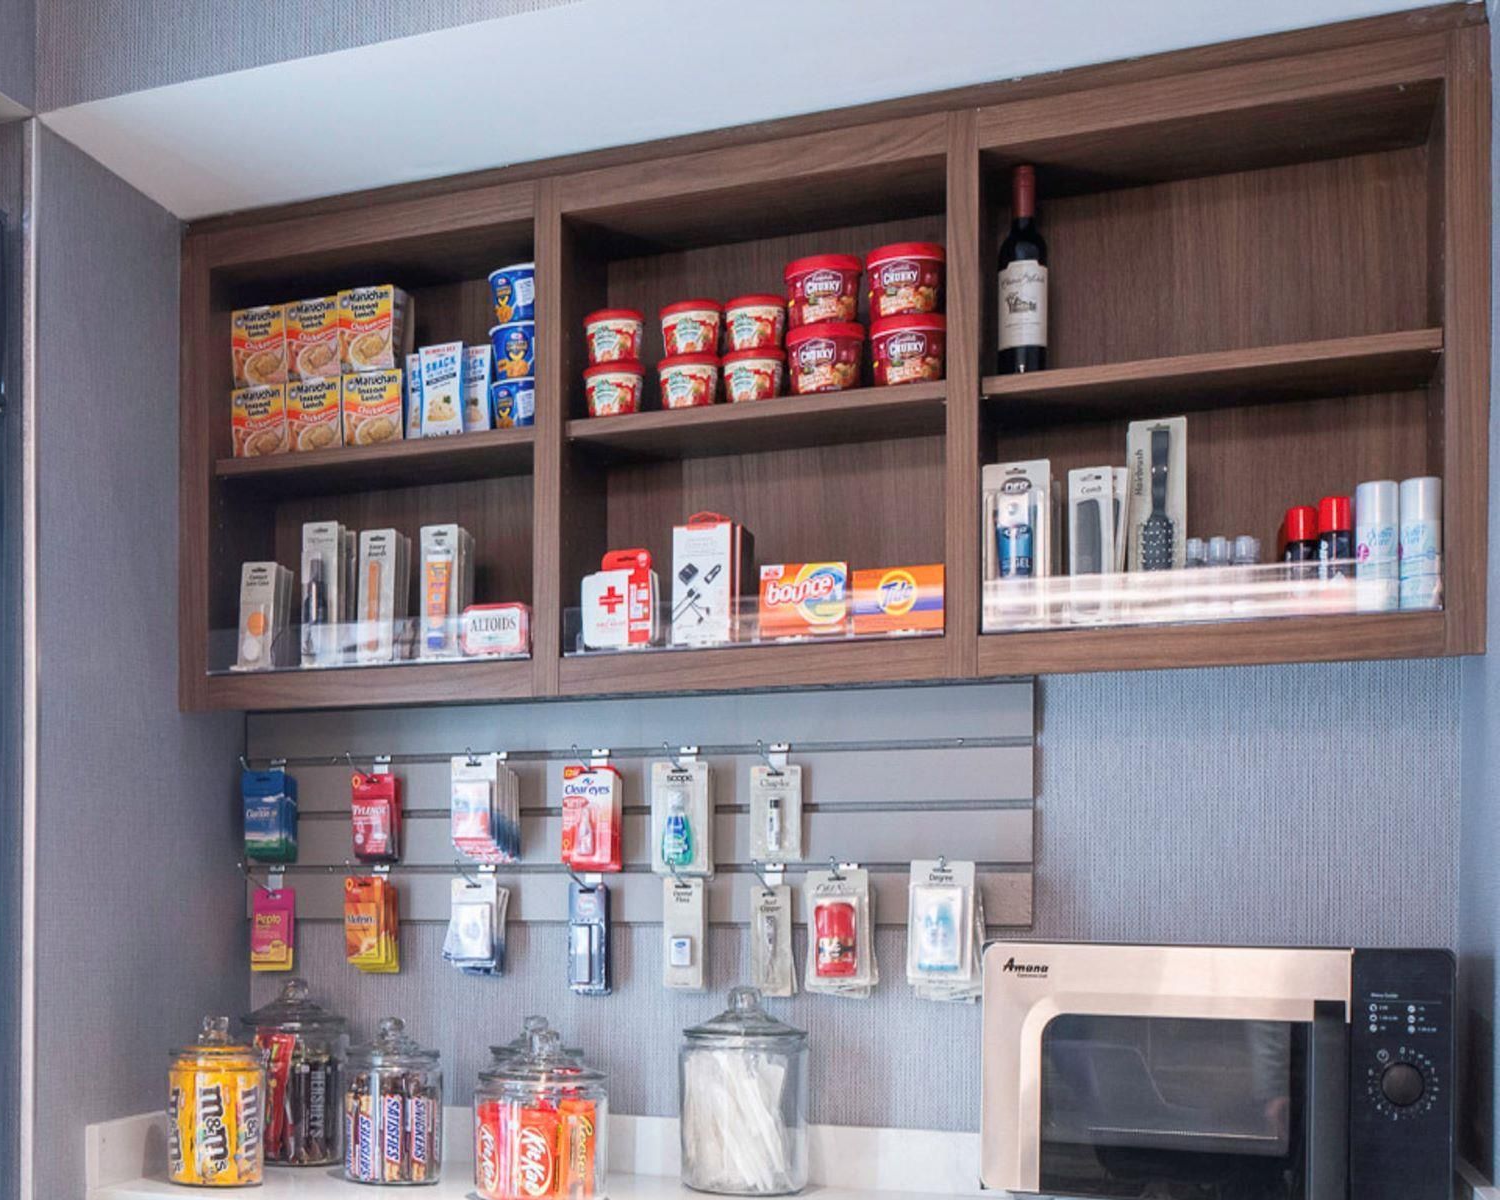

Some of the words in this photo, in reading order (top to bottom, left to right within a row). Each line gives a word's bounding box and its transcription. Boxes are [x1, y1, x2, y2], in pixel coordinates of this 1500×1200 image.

[883, 270, 919, 285] CHUNKY
[805, 279, 841, 294] CHUNKY
[349, 290, 390, 303] Maruchan
[297, 300, 336, 313] Maruchan
[244, 309, 282, 322] Maruchan
[888, 341, 926, 355] CHUNKY
[356, 374, 398, 387] Maruchan
[242, 388, 280, 400] Maruchan
[297, 381, 337, 394] Maruchan
[766, 575, 834, 606] bounce
[880, 580, 914, 608] Tide
[470, 616, 517, 633] ALTOIDS
[666, 774, 694, 784] scope
[565, 784, 587, 796] Clear
[588, 785, 611, 797] eyes
[352, 804, 389, 816] TYLENOL
[929, 873, 954, 884] Degree
[256, 913, 281, 925] Pepto
[1003, 957, 1049, 974] Amana
